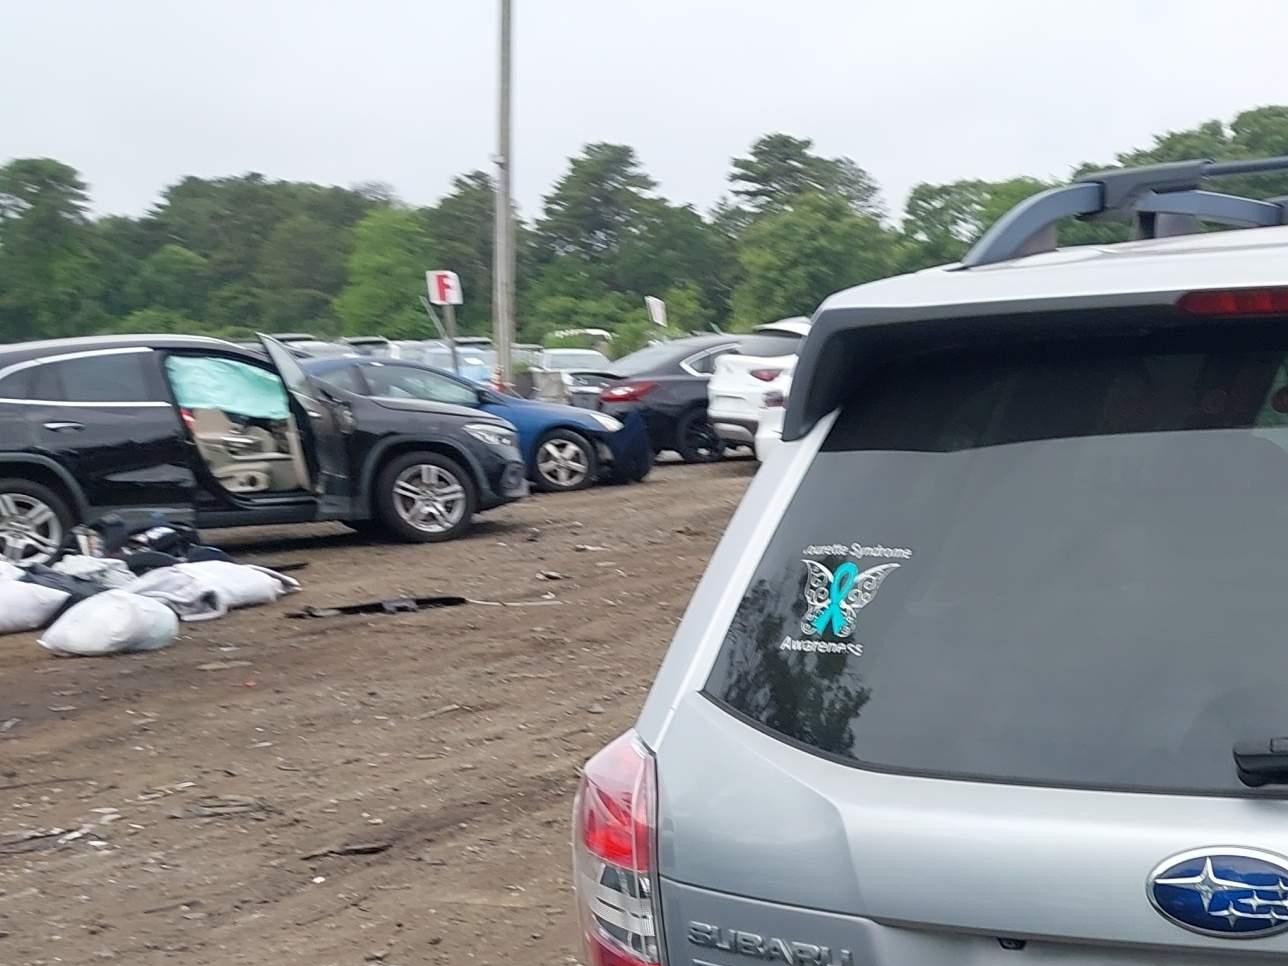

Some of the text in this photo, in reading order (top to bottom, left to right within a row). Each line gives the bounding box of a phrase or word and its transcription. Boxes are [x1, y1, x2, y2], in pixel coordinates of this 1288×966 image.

[436, 274, 452, 301] F
[850, 542, 913, 560] Syndrome
[779, 635, 864, 657] Awareness
